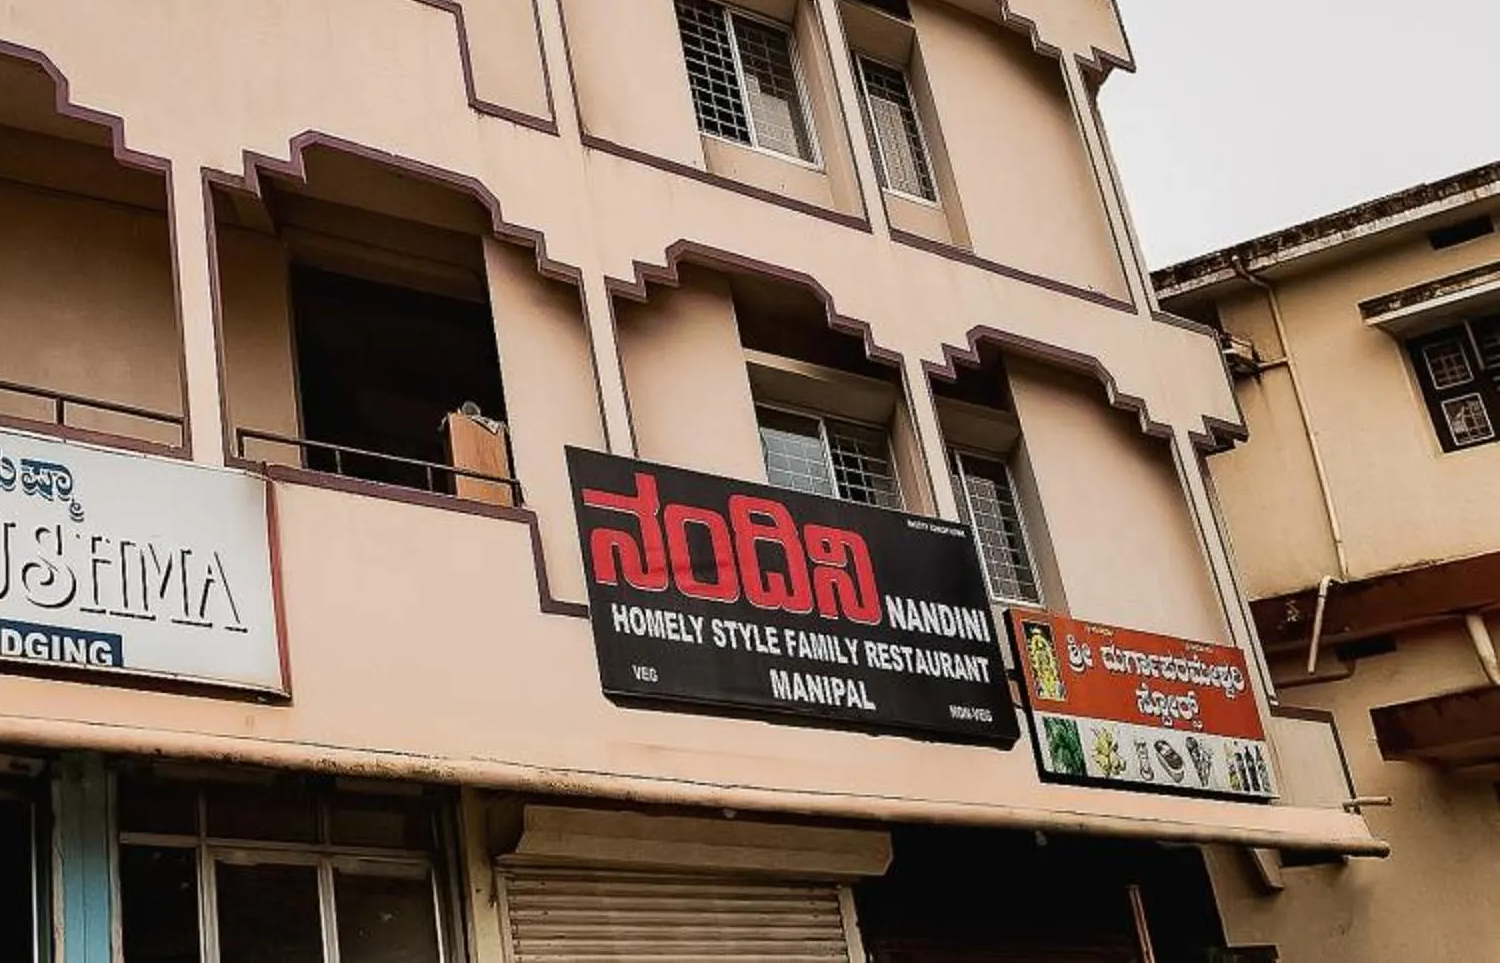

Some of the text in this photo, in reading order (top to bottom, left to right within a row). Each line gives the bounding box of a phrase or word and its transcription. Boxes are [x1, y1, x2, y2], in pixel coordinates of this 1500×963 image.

[582, 472, 883, 625] ನಂದಿನಿ
[885, 594, 991, 642] NANDINI
[611, 603, 990, 684] HOMELY STYLE FAMILY RESTAURANT
[1067, 634, 1093, 672] ಶ್ರೀ
[632, 665, 658, 682] VEG
[770, 669, 877, 711] MANIPAL
[949, 704, 993, 723] NON-VEG
